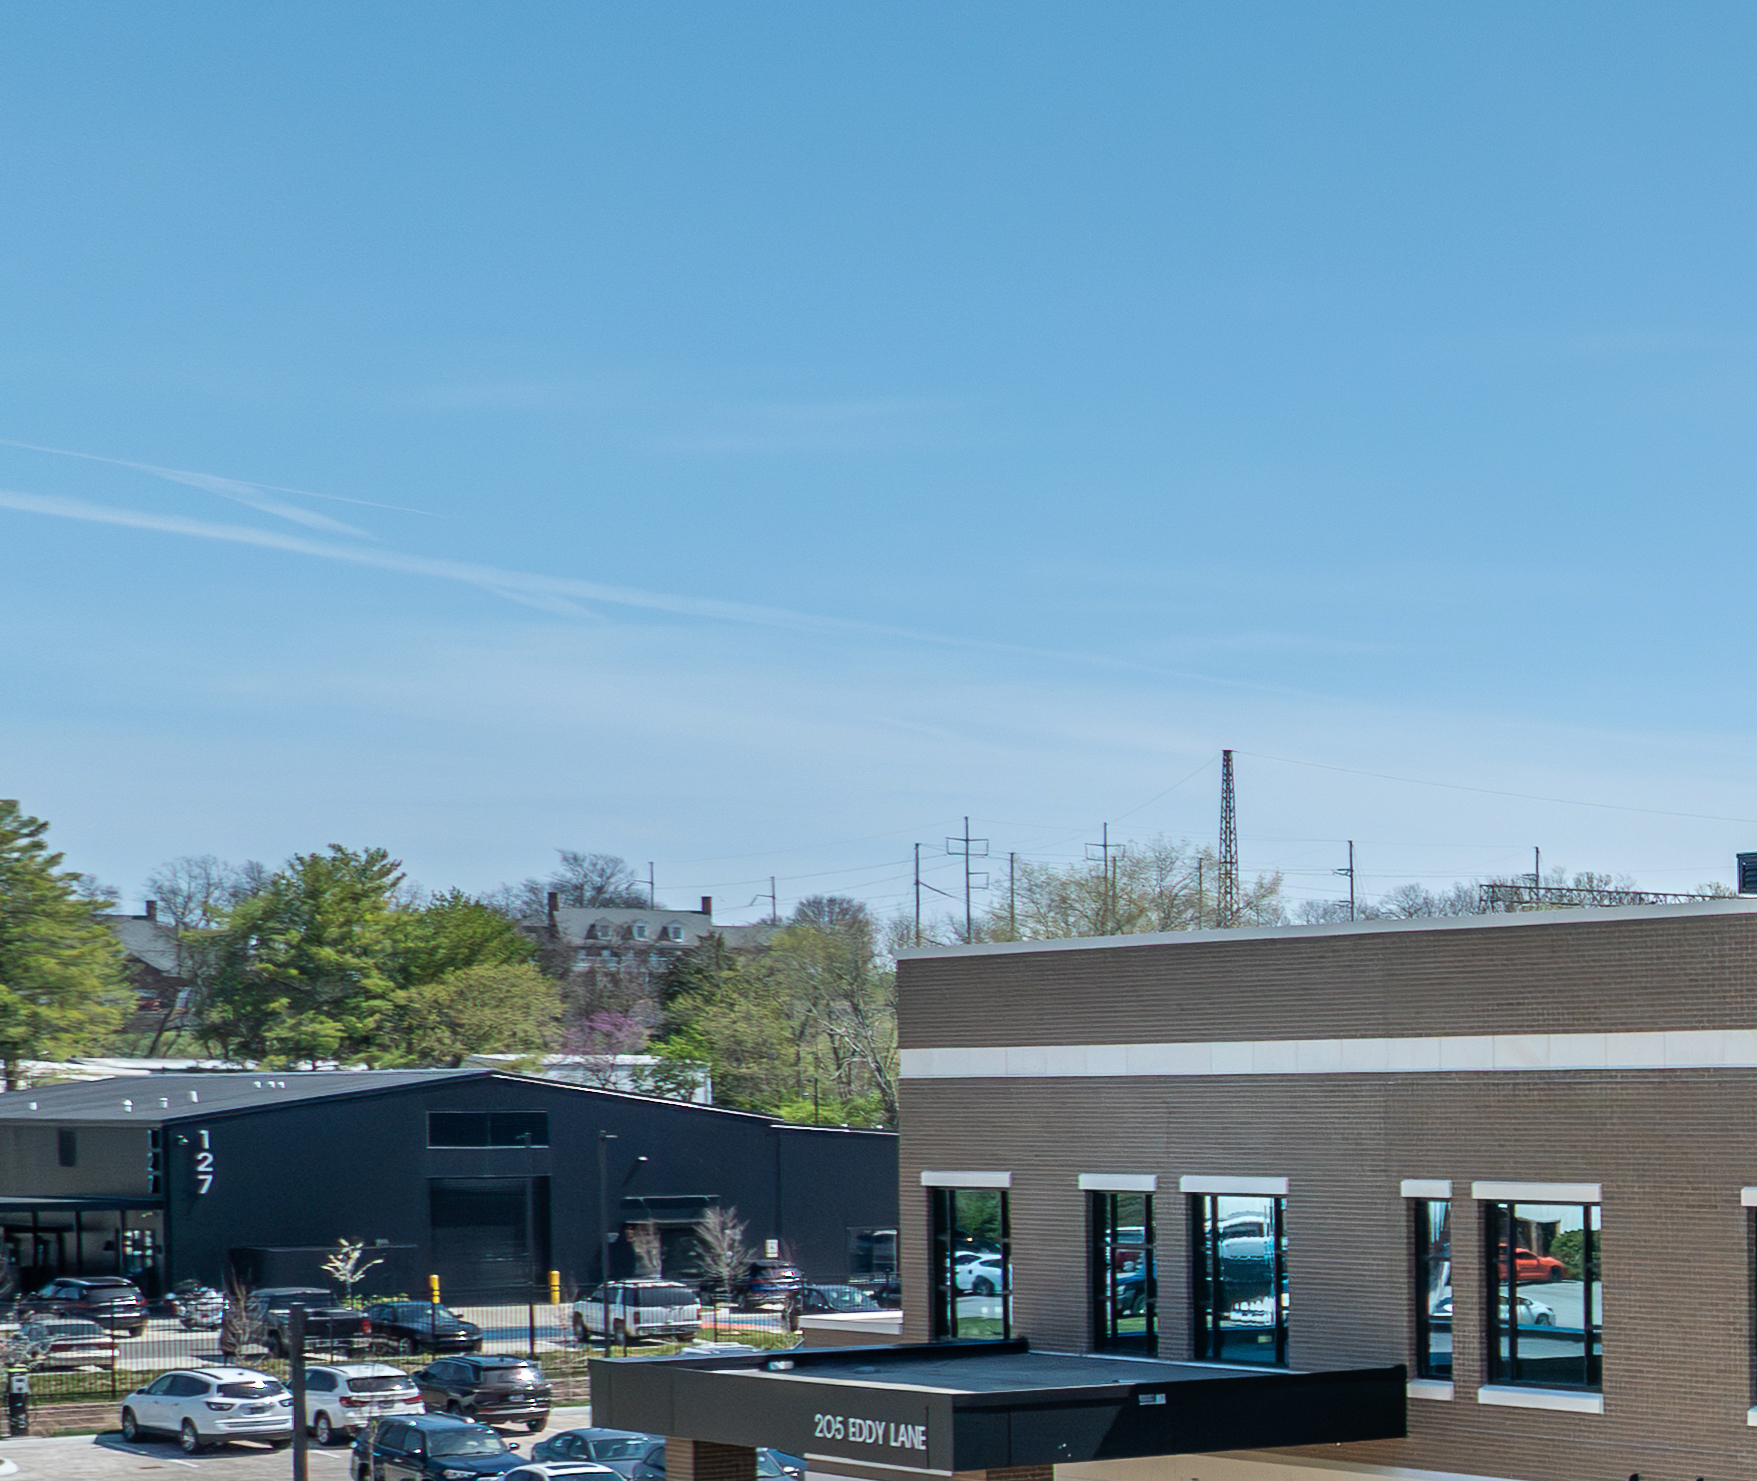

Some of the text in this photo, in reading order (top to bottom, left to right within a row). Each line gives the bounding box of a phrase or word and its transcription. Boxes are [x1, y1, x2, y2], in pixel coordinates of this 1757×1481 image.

[198, 1129, 214, 1194] 127
[813, 1413, 927, 1450] 205 EDDY LANE
